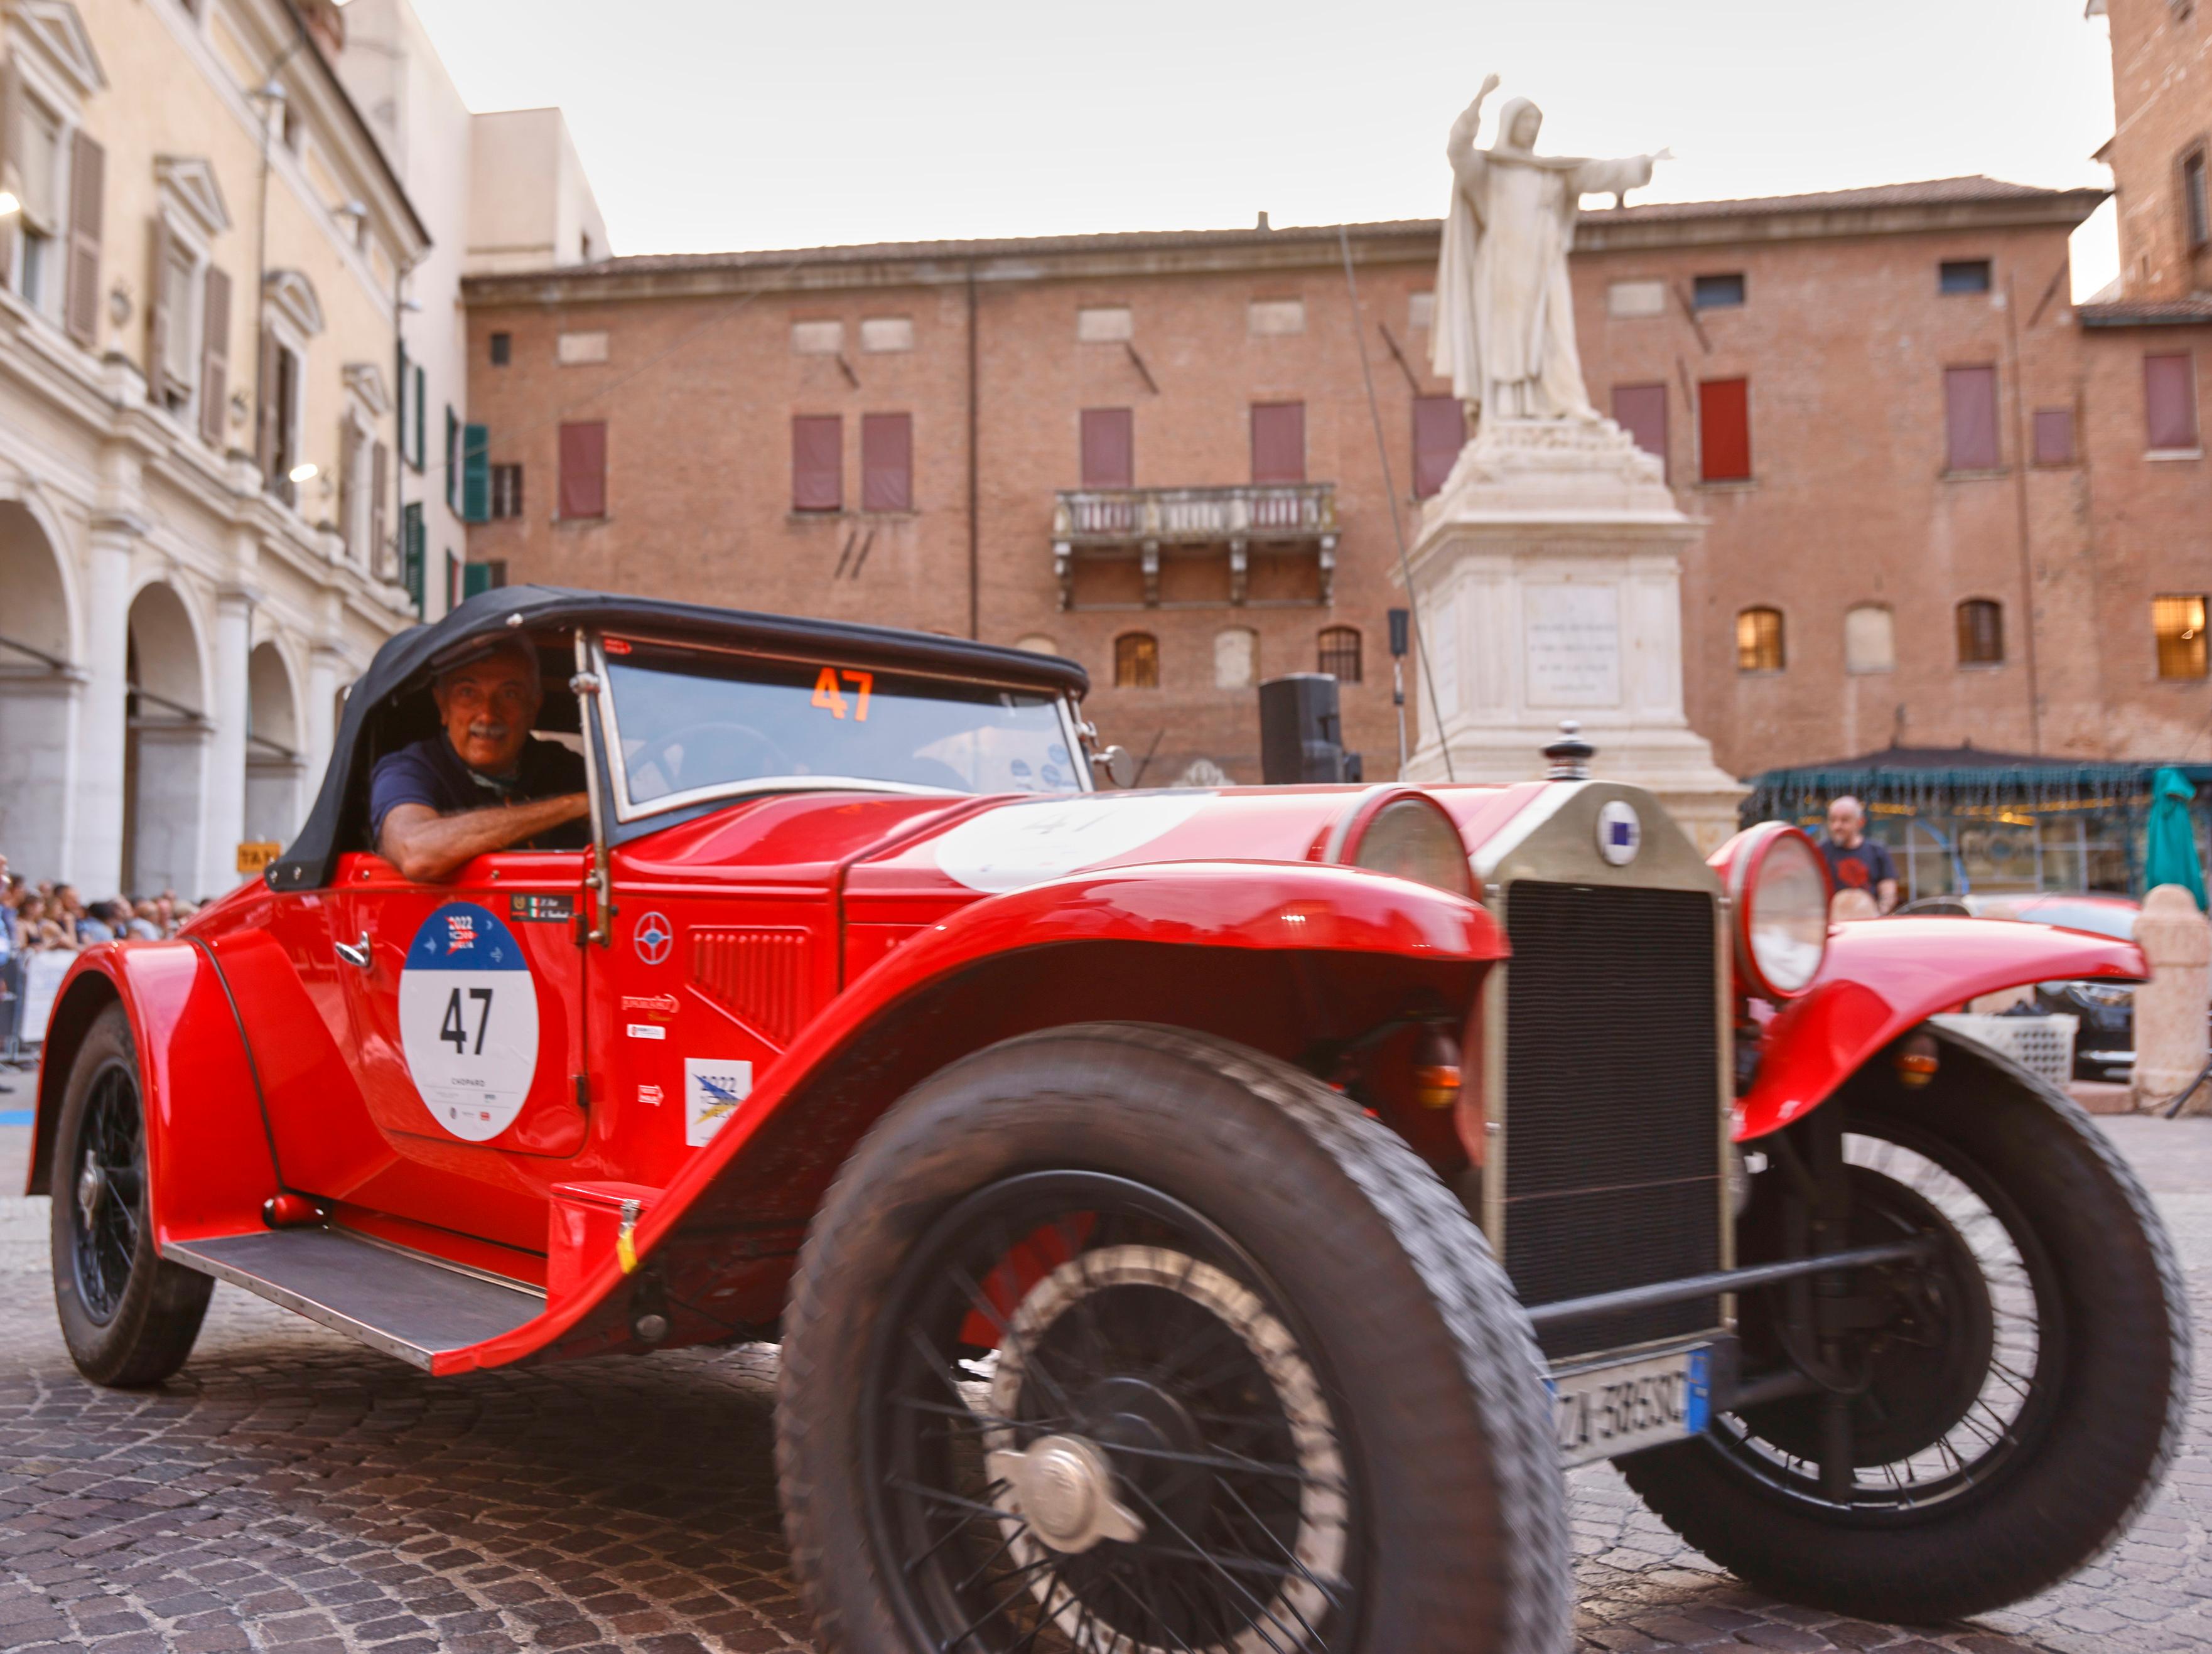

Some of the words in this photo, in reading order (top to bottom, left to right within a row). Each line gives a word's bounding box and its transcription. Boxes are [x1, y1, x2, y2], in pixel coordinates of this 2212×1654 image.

[811, 667, 873, 722] 47
[448, 916, 473, 930] 2022
[440, 987, 493, 1055] 47
[700, 1075, 737, 1092] 2022
